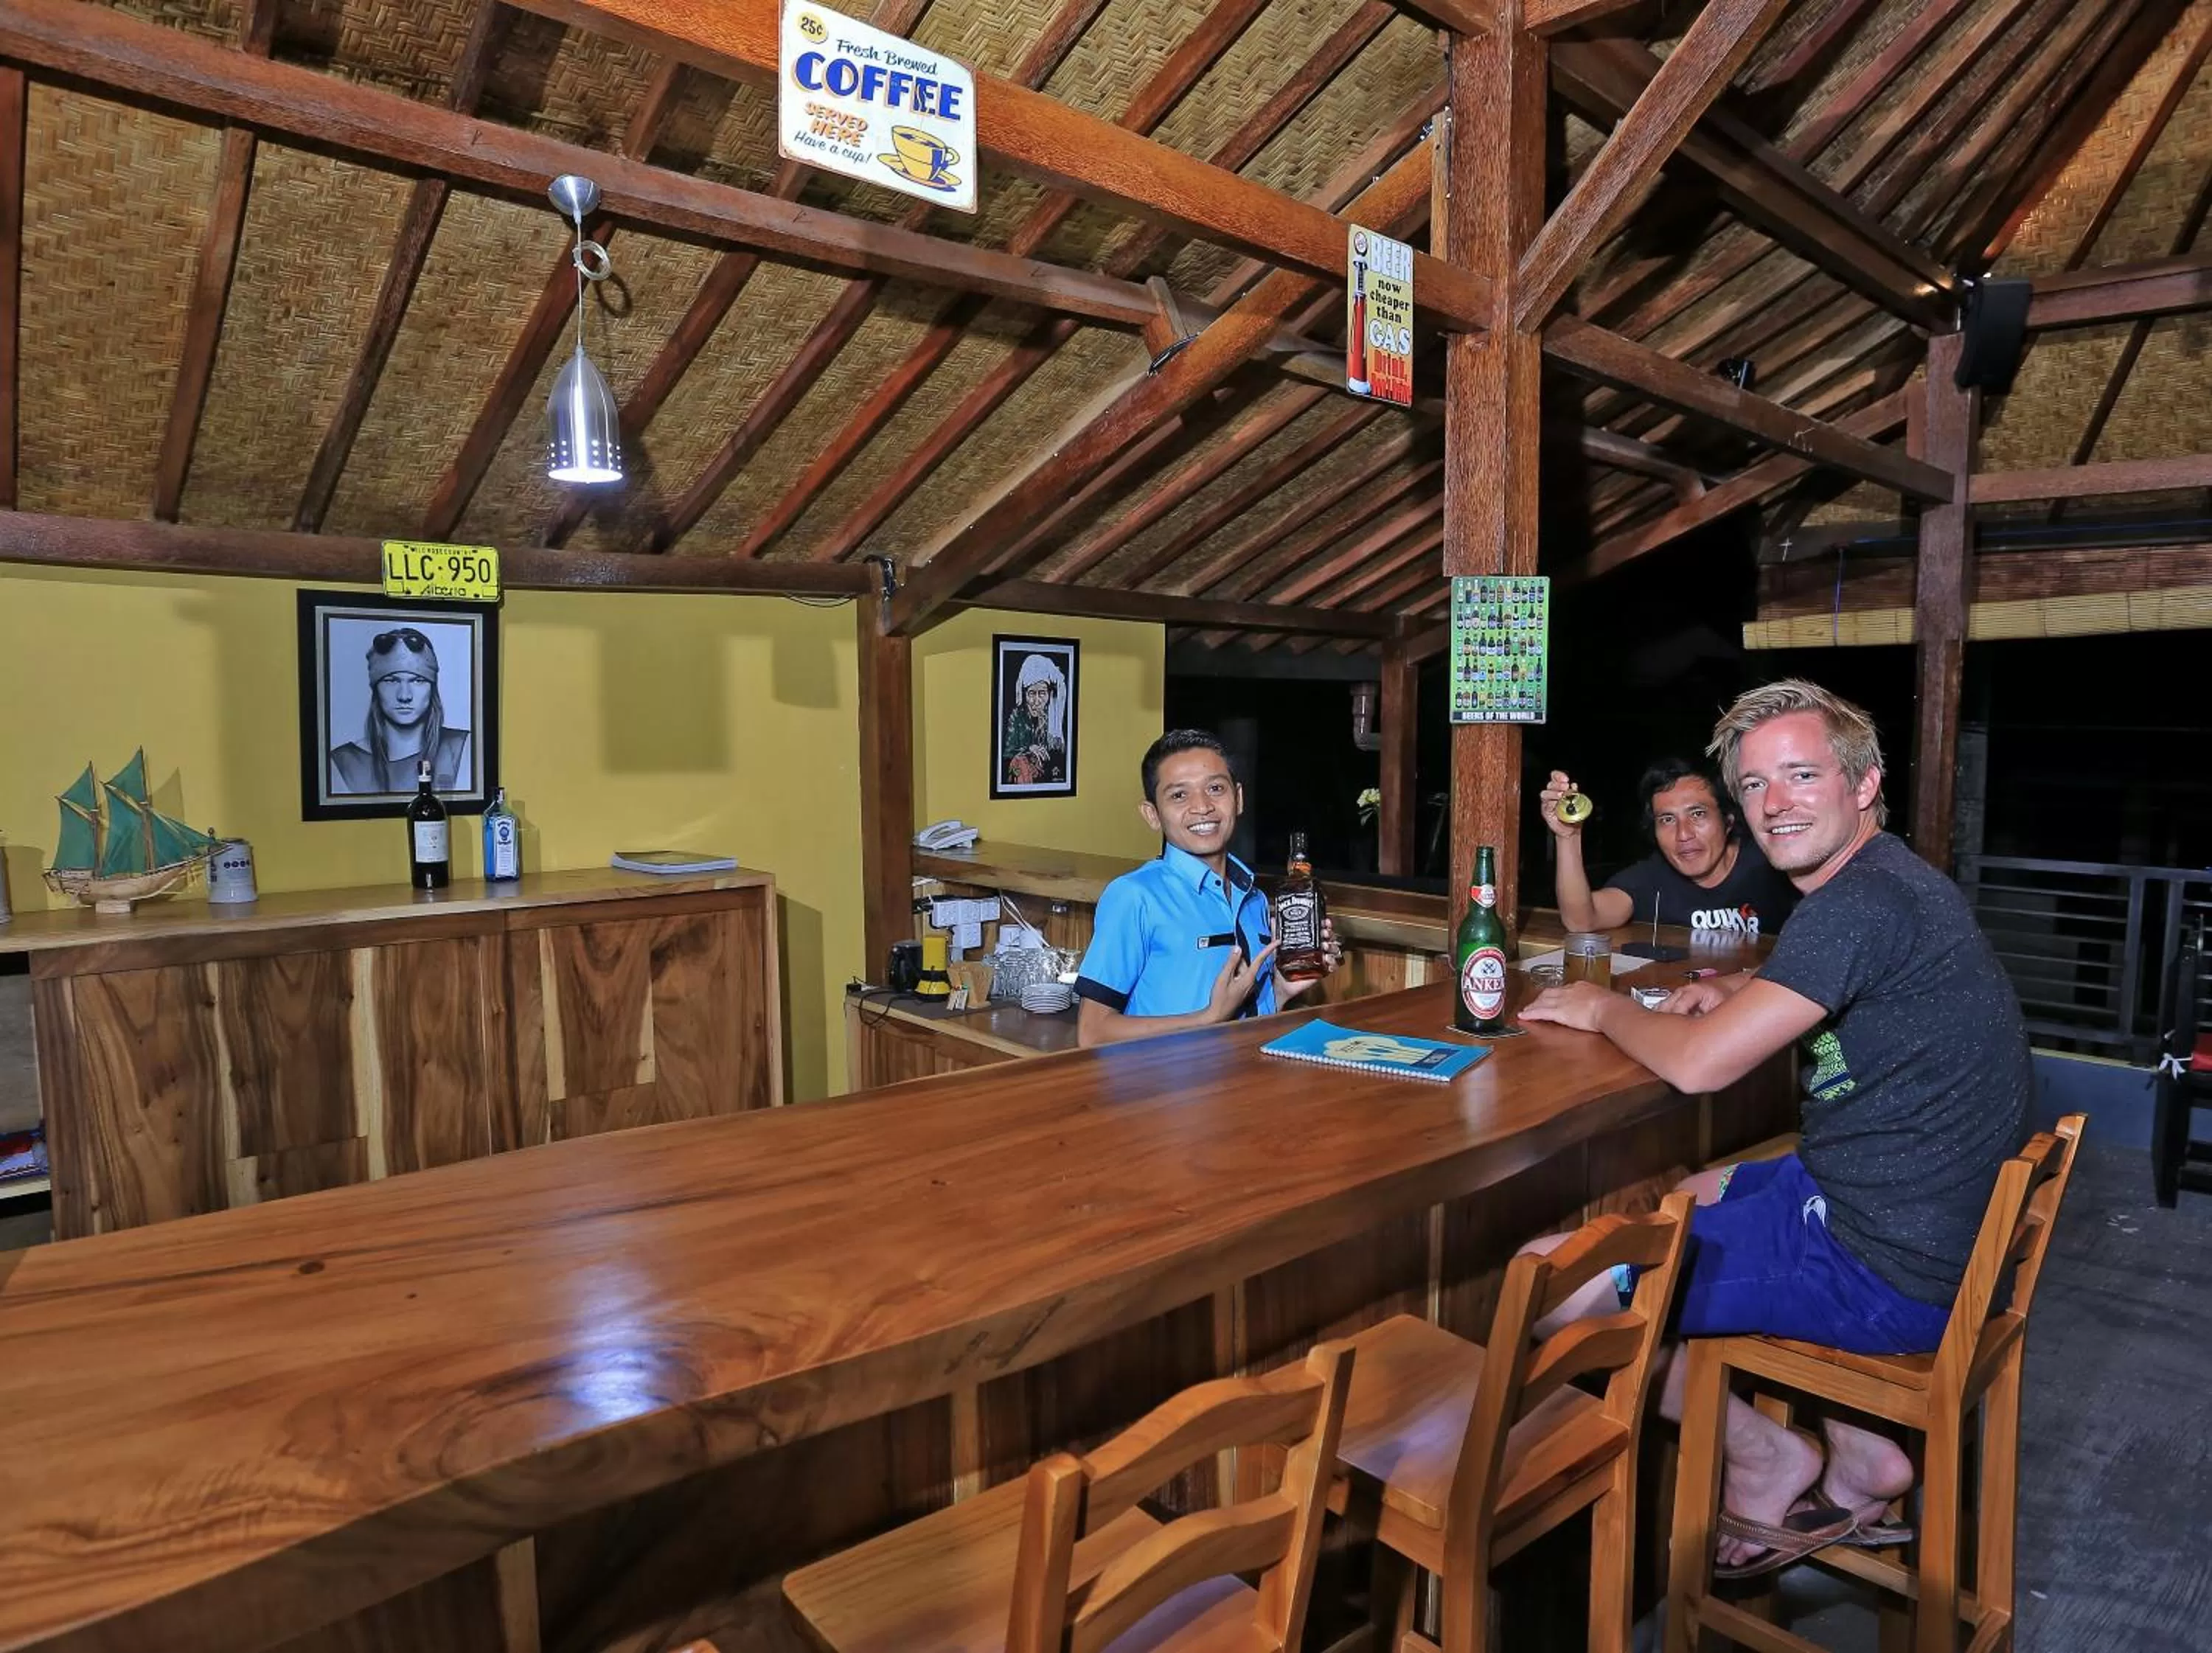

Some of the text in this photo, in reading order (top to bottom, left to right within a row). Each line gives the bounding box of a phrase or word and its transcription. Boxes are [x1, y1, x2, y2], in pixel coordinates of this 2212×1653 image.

[836, 39, 938, 76] Fresh Brewed
[794, 51, 963, 121] COFFEE
[804, 101, 869, 131] SERVED
[794, 130, 872, 164] Have a cup!
[810, 118, 864, 147] HERE
[1369, 234, 1411, 283] BEER
[1370, 289, 1410, 311] cheaper
[1377, 279, 1402, 293] now
[1377, 306, 1402, 323] than
[1369, 319, 1411, 355] GAS
